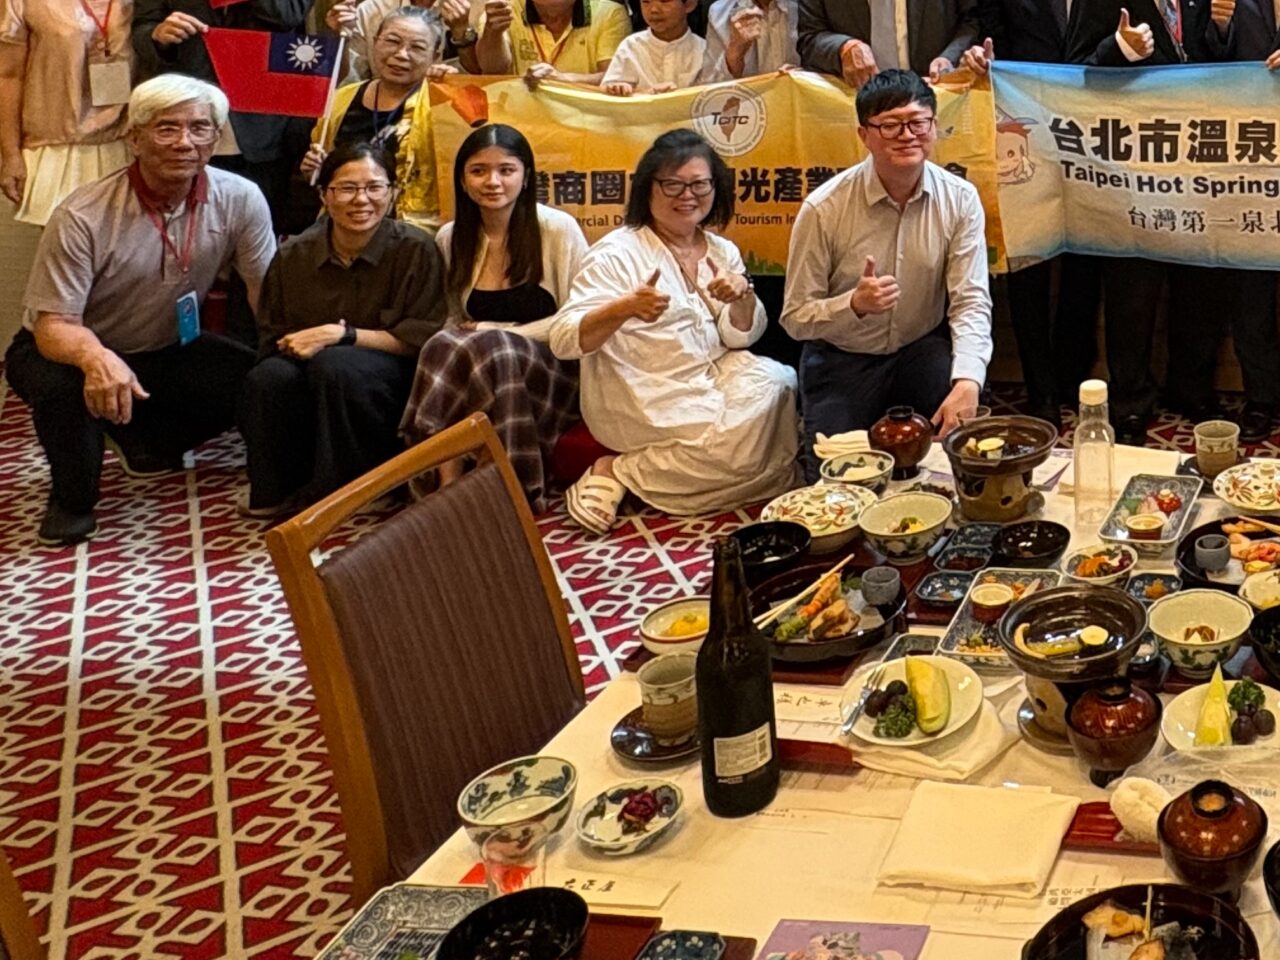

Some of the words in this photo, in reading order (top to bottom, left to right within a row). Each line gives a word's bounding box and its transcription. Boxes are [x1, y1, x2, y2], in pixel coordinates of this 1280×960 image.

[1060, 160, 1130, 189] Taipei
[1136, 175, 1184, 194] Hot
[735, 213, 783, 225] Tourism
